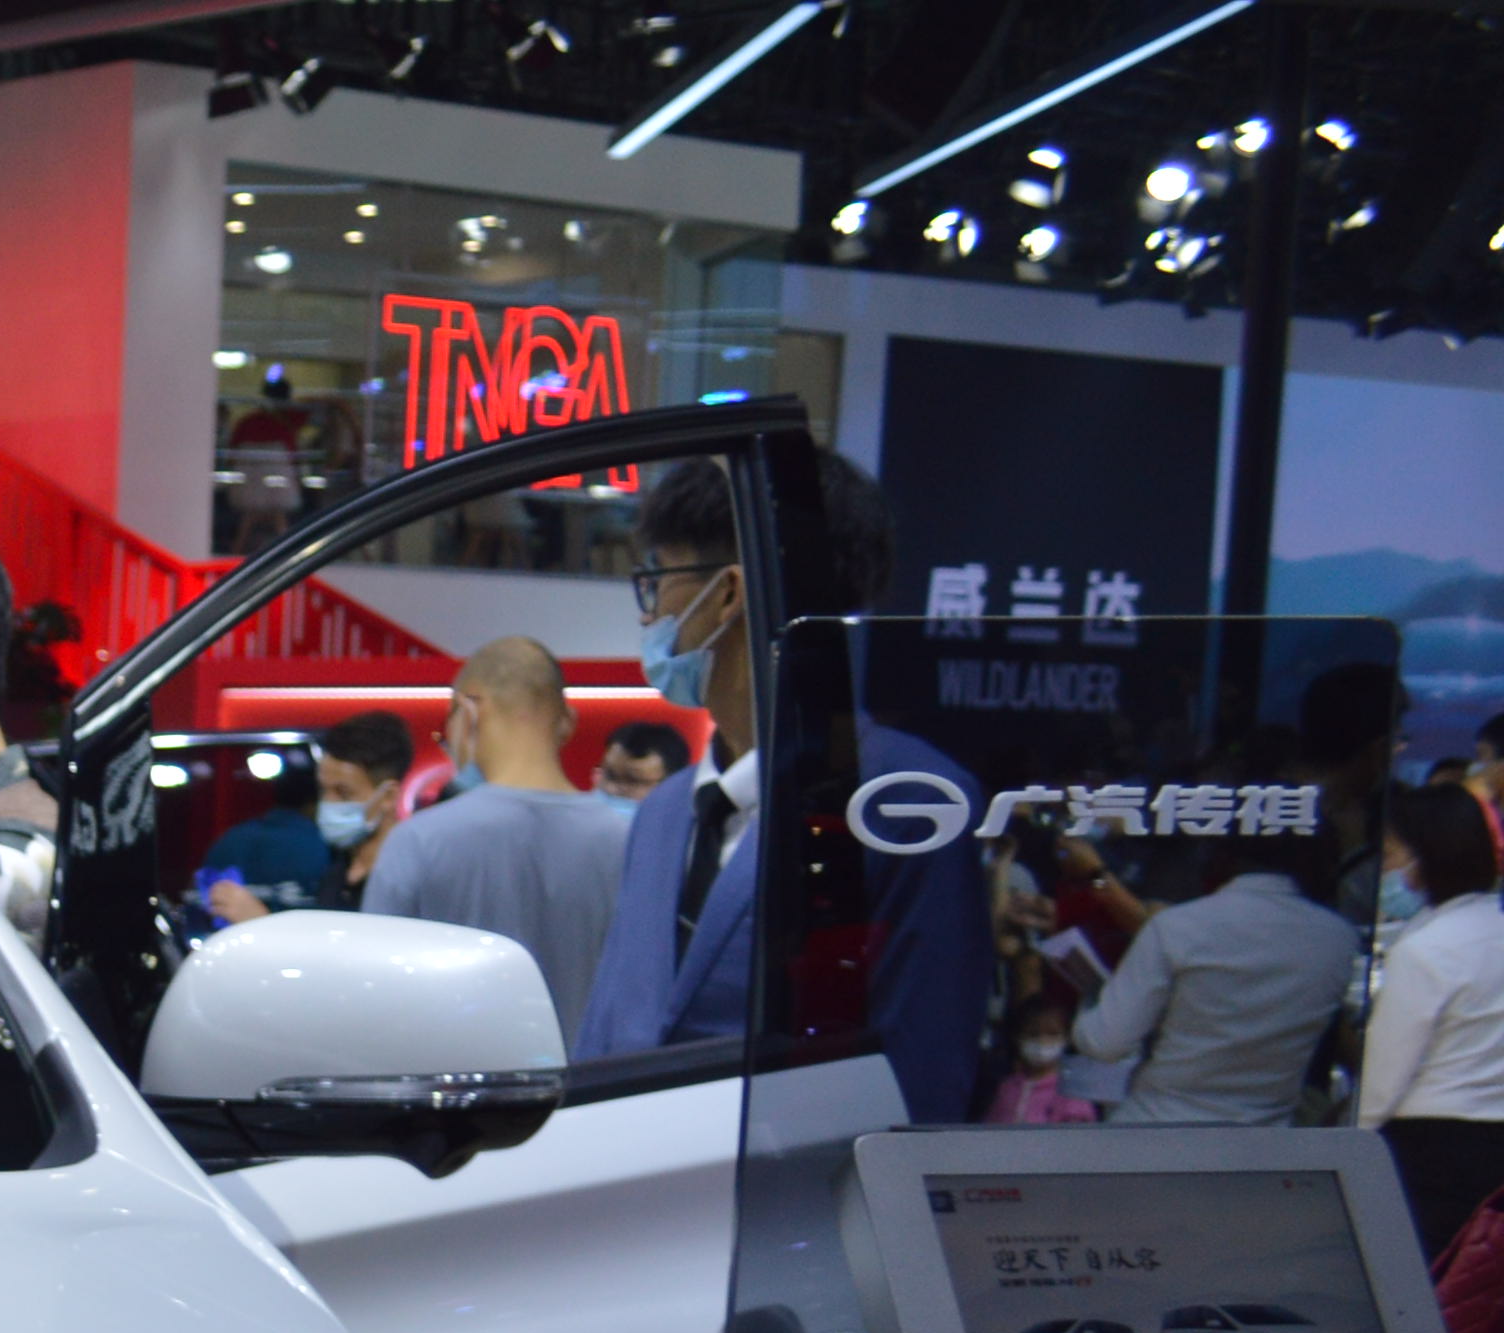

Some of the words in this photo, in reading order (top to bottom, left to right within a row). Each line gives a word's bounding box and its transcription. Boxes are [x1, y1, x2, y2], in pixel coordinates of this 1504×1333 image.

[925, 563, 1142, 645] 威兰达
[940, 660, 1121, 713] WILDLANDER
[974, 784, 1320, 838] 广汽传祺
